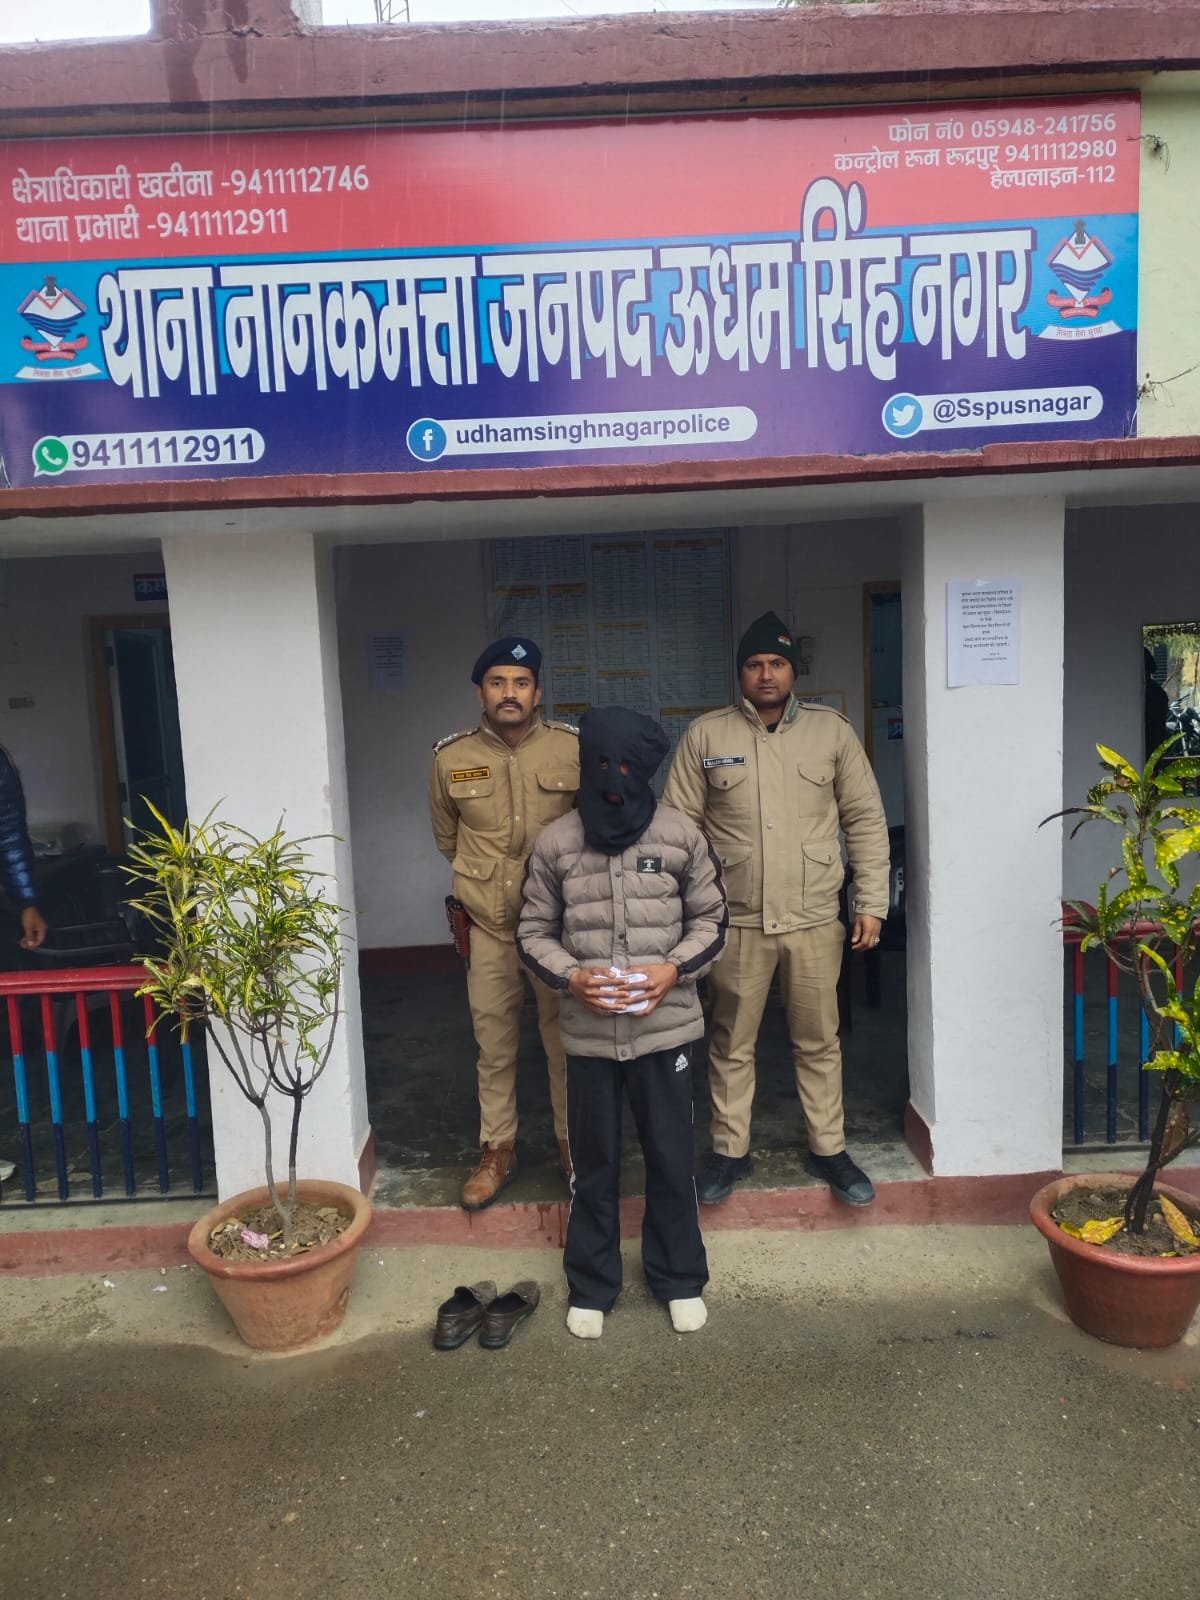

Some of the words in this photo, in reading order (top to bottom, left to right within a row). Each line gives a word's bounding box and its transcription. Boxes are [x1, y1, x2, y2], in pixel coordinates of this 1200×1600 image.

[888, 118, 930, 143] फोन
[971, 113, 1116, 138] 05948-241756
[833, 145, 900, 174] कन्ट्रोल
[904, 148, 941, 168] रूम
[1005, 139, 1117, 163] 9411112980
[12, 164, 131, 203] क्षेत्राधिकारी
[137, 162, 214, 198] खटीमा
[221, 165, 369, 196] -9411112746
[990, 164, 1116, 189] हेल्पलाइन-112
[16, 215, 69, 243] थाना
[75, 204, 140, 243] प्रभारी
[147, 207, 288, 238] -9411112911
[99, 265, 217, 398] थाना
[219, 256, 478, 392] नानकमत्ता
[482, 249, 653, 382] जनपद
[660, 242, 793, 376] ऊधम
[801, 178, 903, 381] सिंह
[910, 229, 1032, 361] नगर
[933, 394, 1092, 423] @Sspusnagar
[456, 413, 730, 444] udhamsinghnagarpolice
[72, 433, 255, 468] 9411112911
